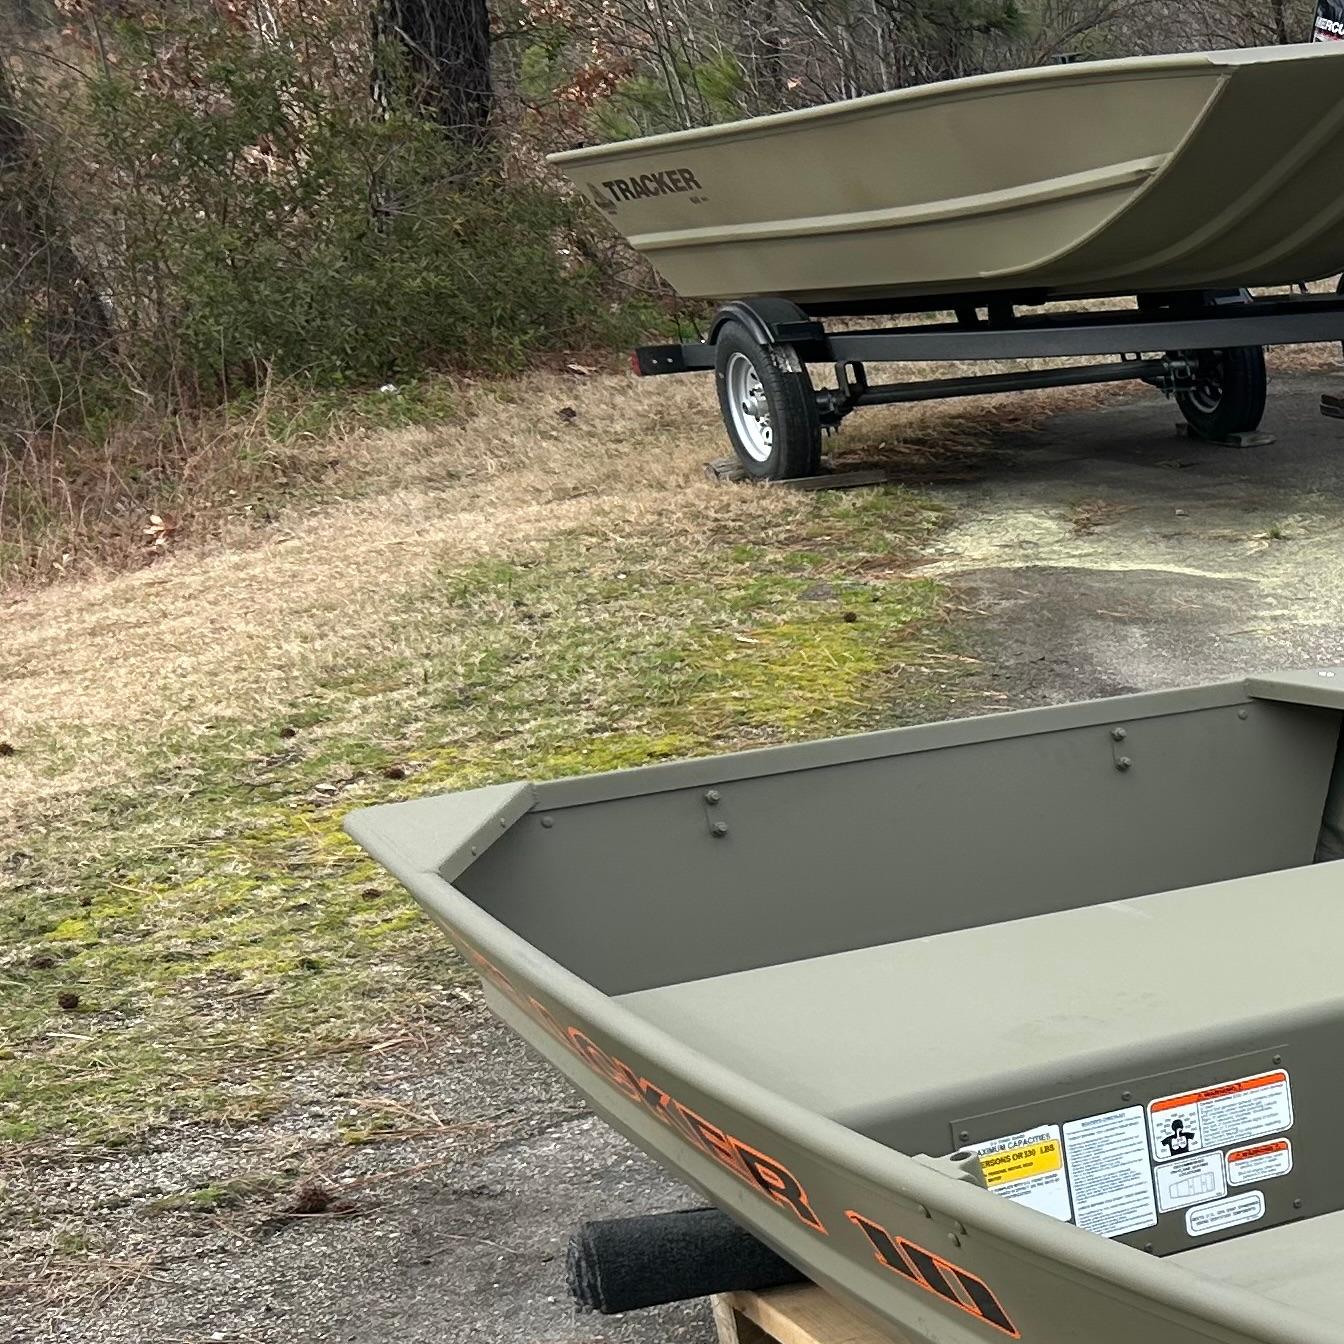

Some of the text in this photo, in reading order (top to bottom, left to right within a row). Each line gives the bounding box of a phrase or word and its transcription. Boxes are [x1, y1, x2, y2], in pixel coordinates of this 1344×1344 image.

[601, 168, 702, 202] TRACKER
[977, 1144, 1006, 1156] AXIMUM
[1007, 1133, 1051, 1150] CAPACITIES
[982, 1155, 1011, 1169] ERSONS
[1012, 1152, 1023, 1162] OR
[844, 1209, 1021, 1340] 10
